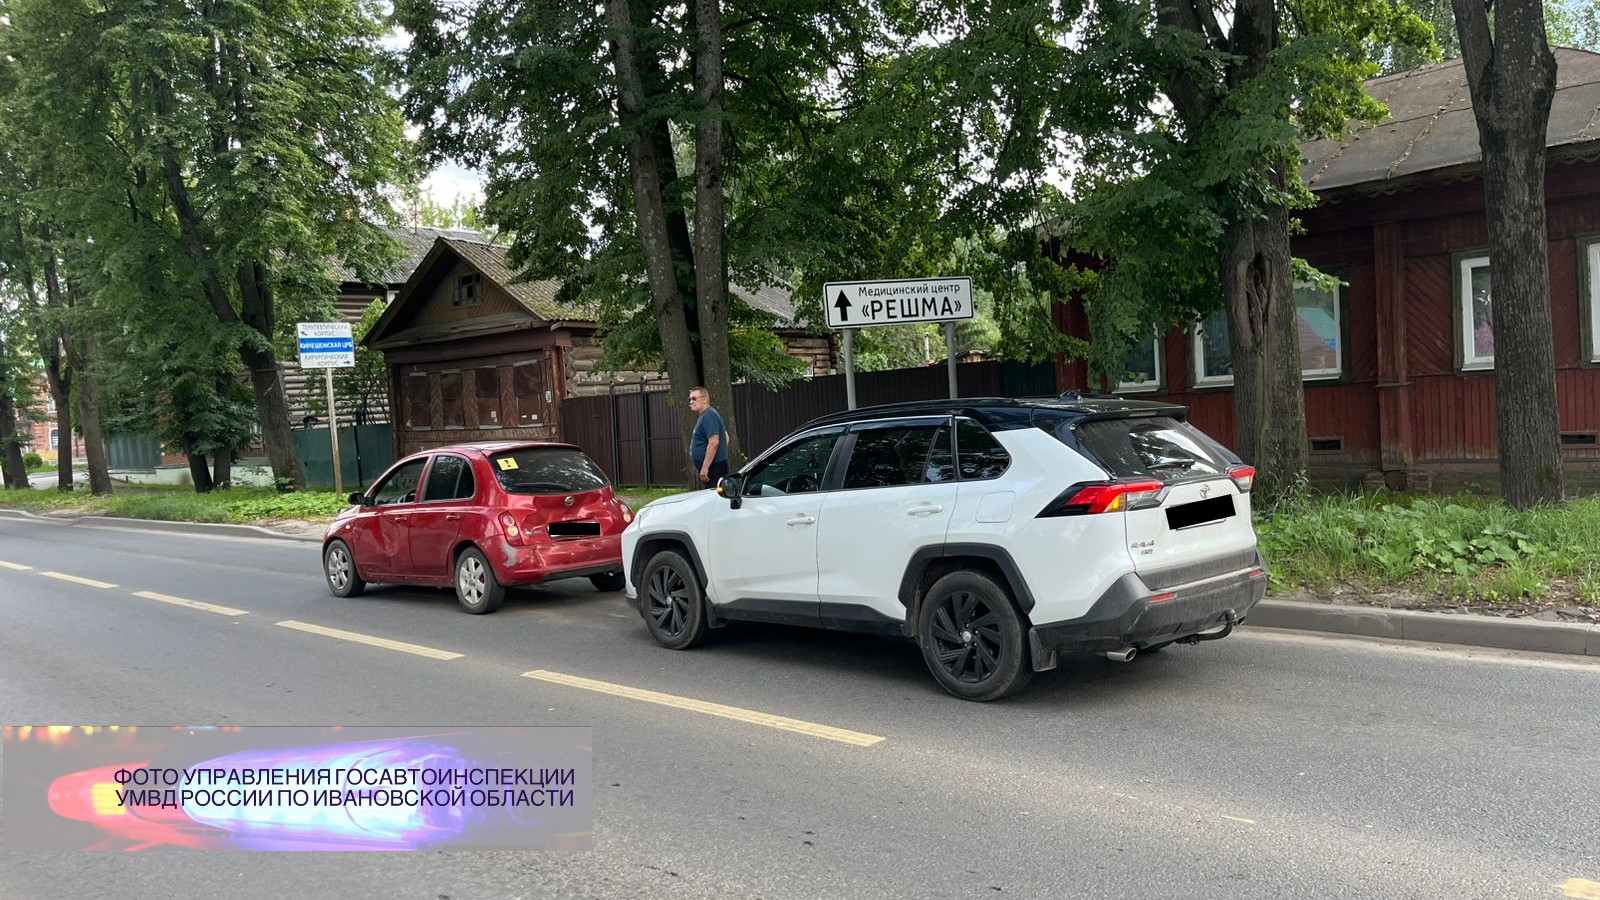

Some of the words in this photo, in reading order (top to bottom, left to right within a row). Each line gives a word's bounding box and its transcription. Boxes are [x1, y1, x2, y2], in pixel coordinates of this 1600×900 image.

[858, 283, 929, 297] Медицинский
[931, 283, 961, 295] центр
[861, 297, 962, 320] «РЕШМА»
